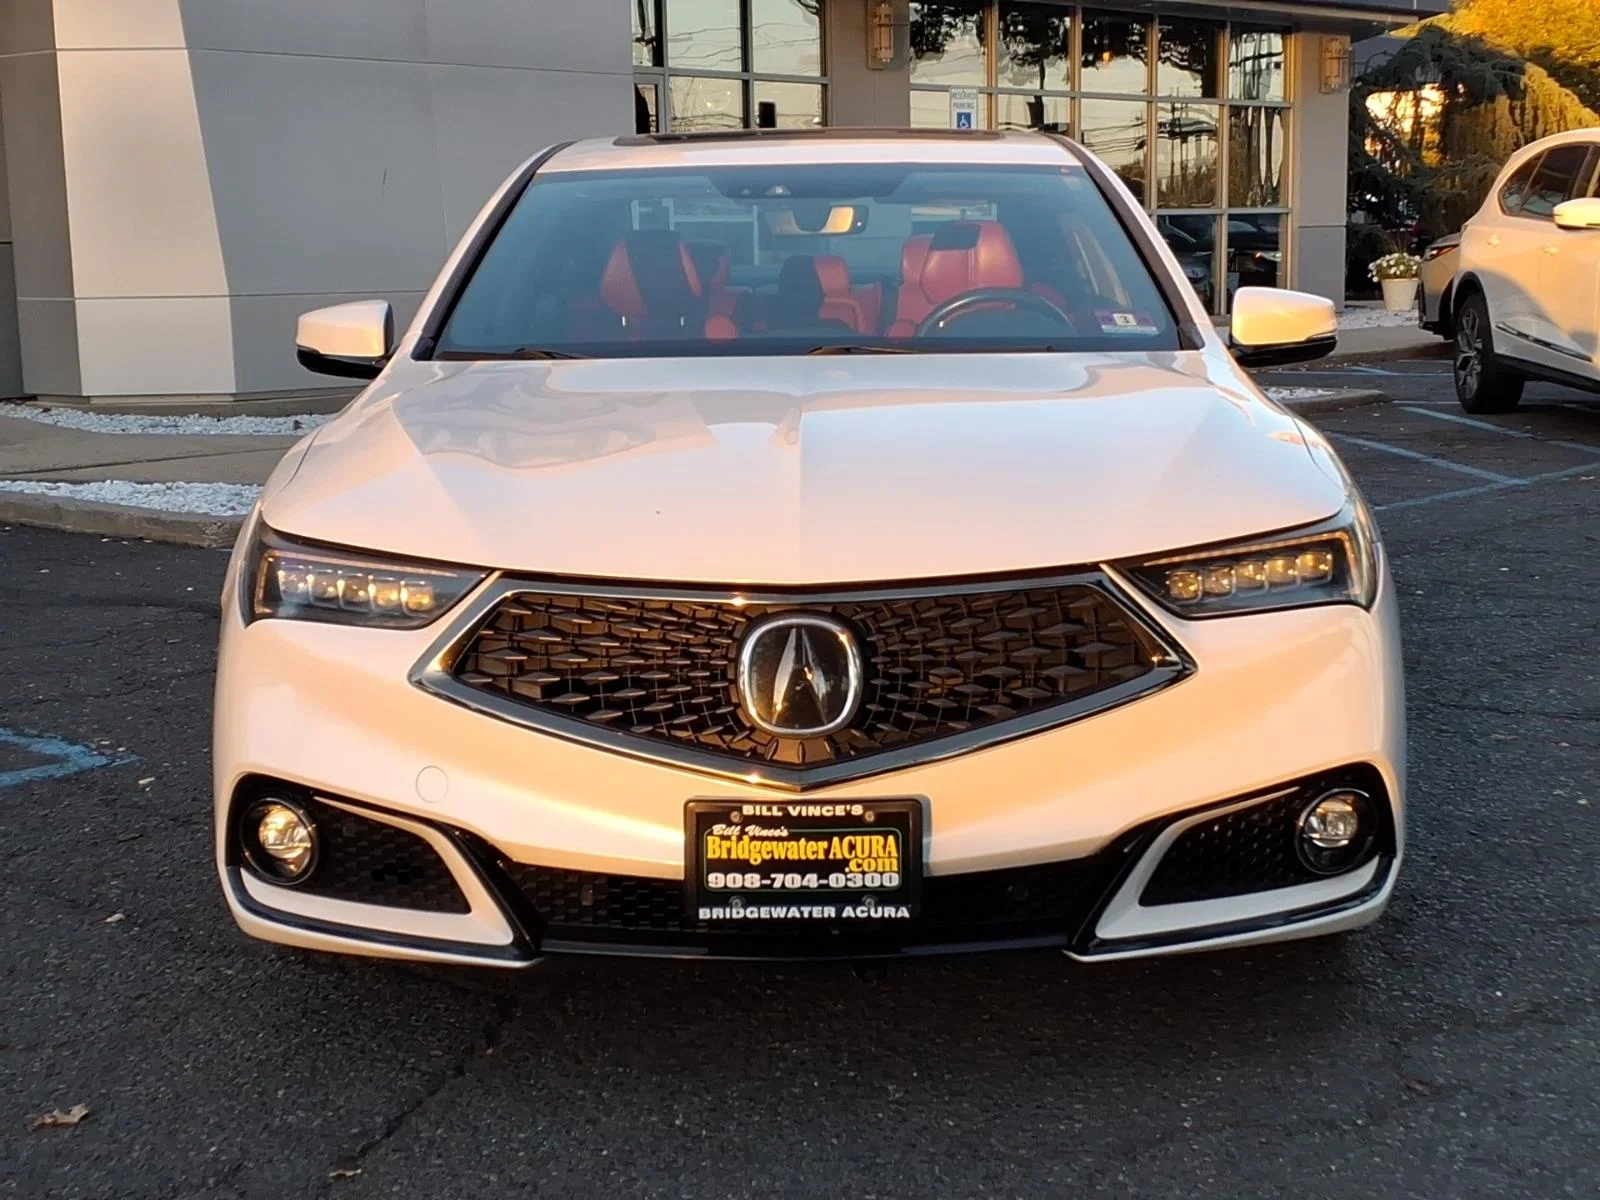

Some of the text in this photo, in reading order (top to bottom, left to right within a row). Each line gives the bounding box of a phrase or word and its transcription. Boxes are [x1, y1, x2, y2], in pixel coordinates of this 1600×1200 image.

[742, 804, 864, 816] BILL VINCE'S
[711, 824, 789, 837] Bill Vince's
[706, 835, 898, 865] Bridgewater ACURA
[845, 857, 899, 873] .com
[707, 872, 899, 888] 908-704-0300
[698, 906, 910, 920] BRIDGEWATER ACURA
